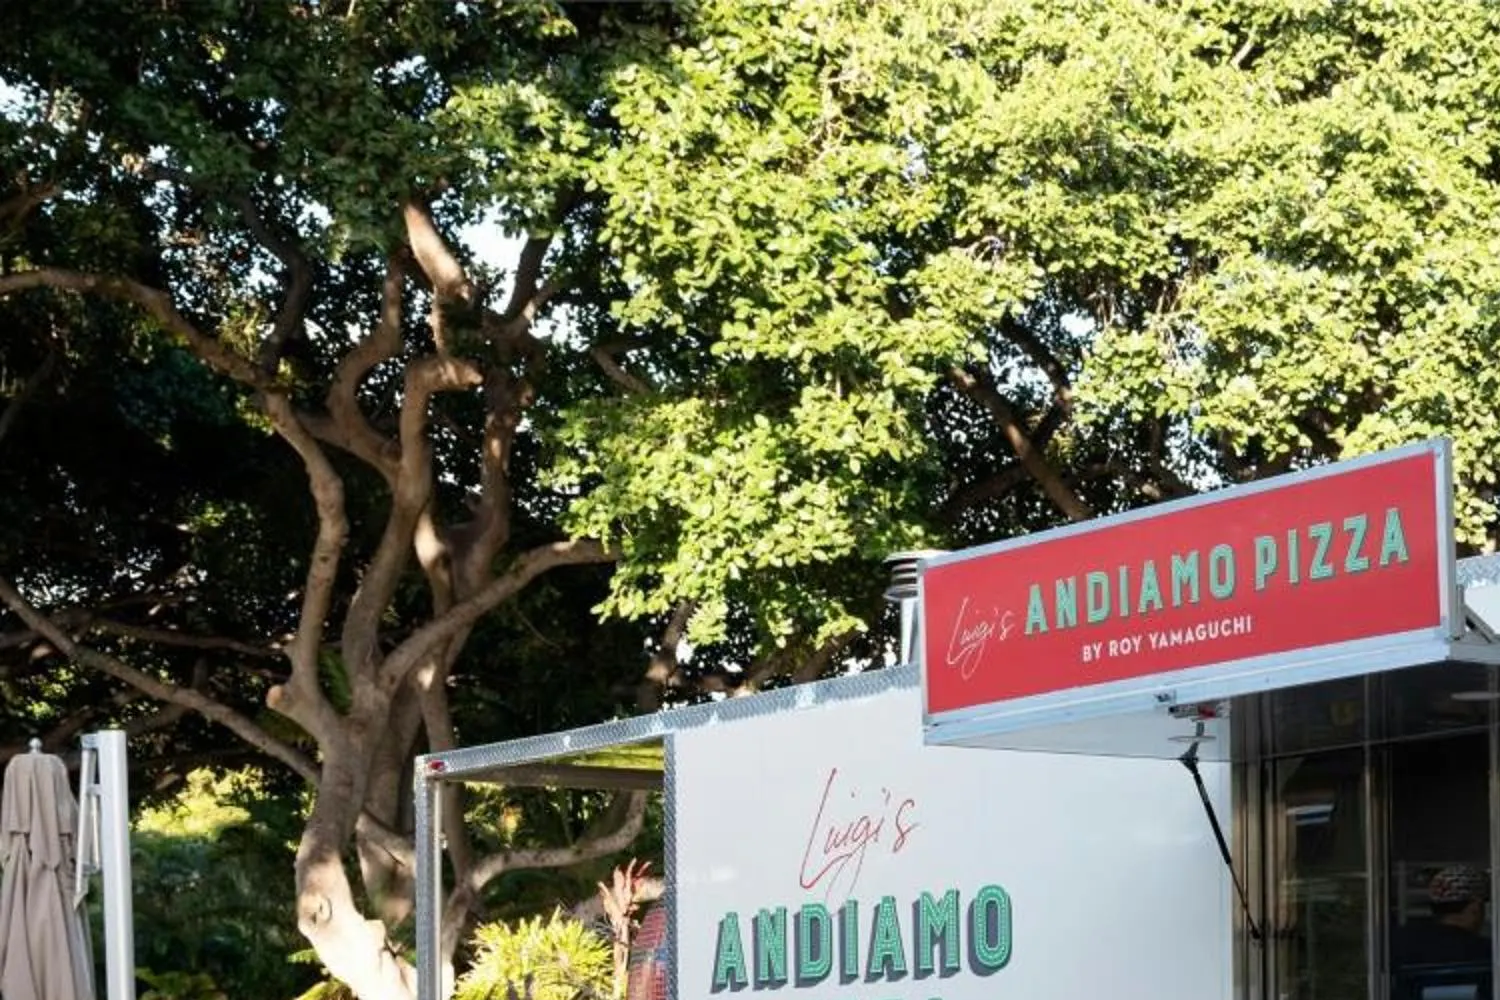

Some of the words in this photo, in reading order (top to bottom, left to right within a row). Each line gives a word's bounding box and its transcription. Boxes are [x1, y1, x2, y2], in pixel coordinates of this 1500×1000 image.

[1023, 543, 1238, 637] ANDIAMO
[1252, 506, 1411, 592] PIZZA
[1081, 643, 1103, 663] BY
[1108, 635, 1143, 658] ROY
[1147, 614, 1253, 650] YAMAGUCHI
[799, 767, 921, 910] Luigi's
[710, 884, 1013, 993] ANDIAMO
